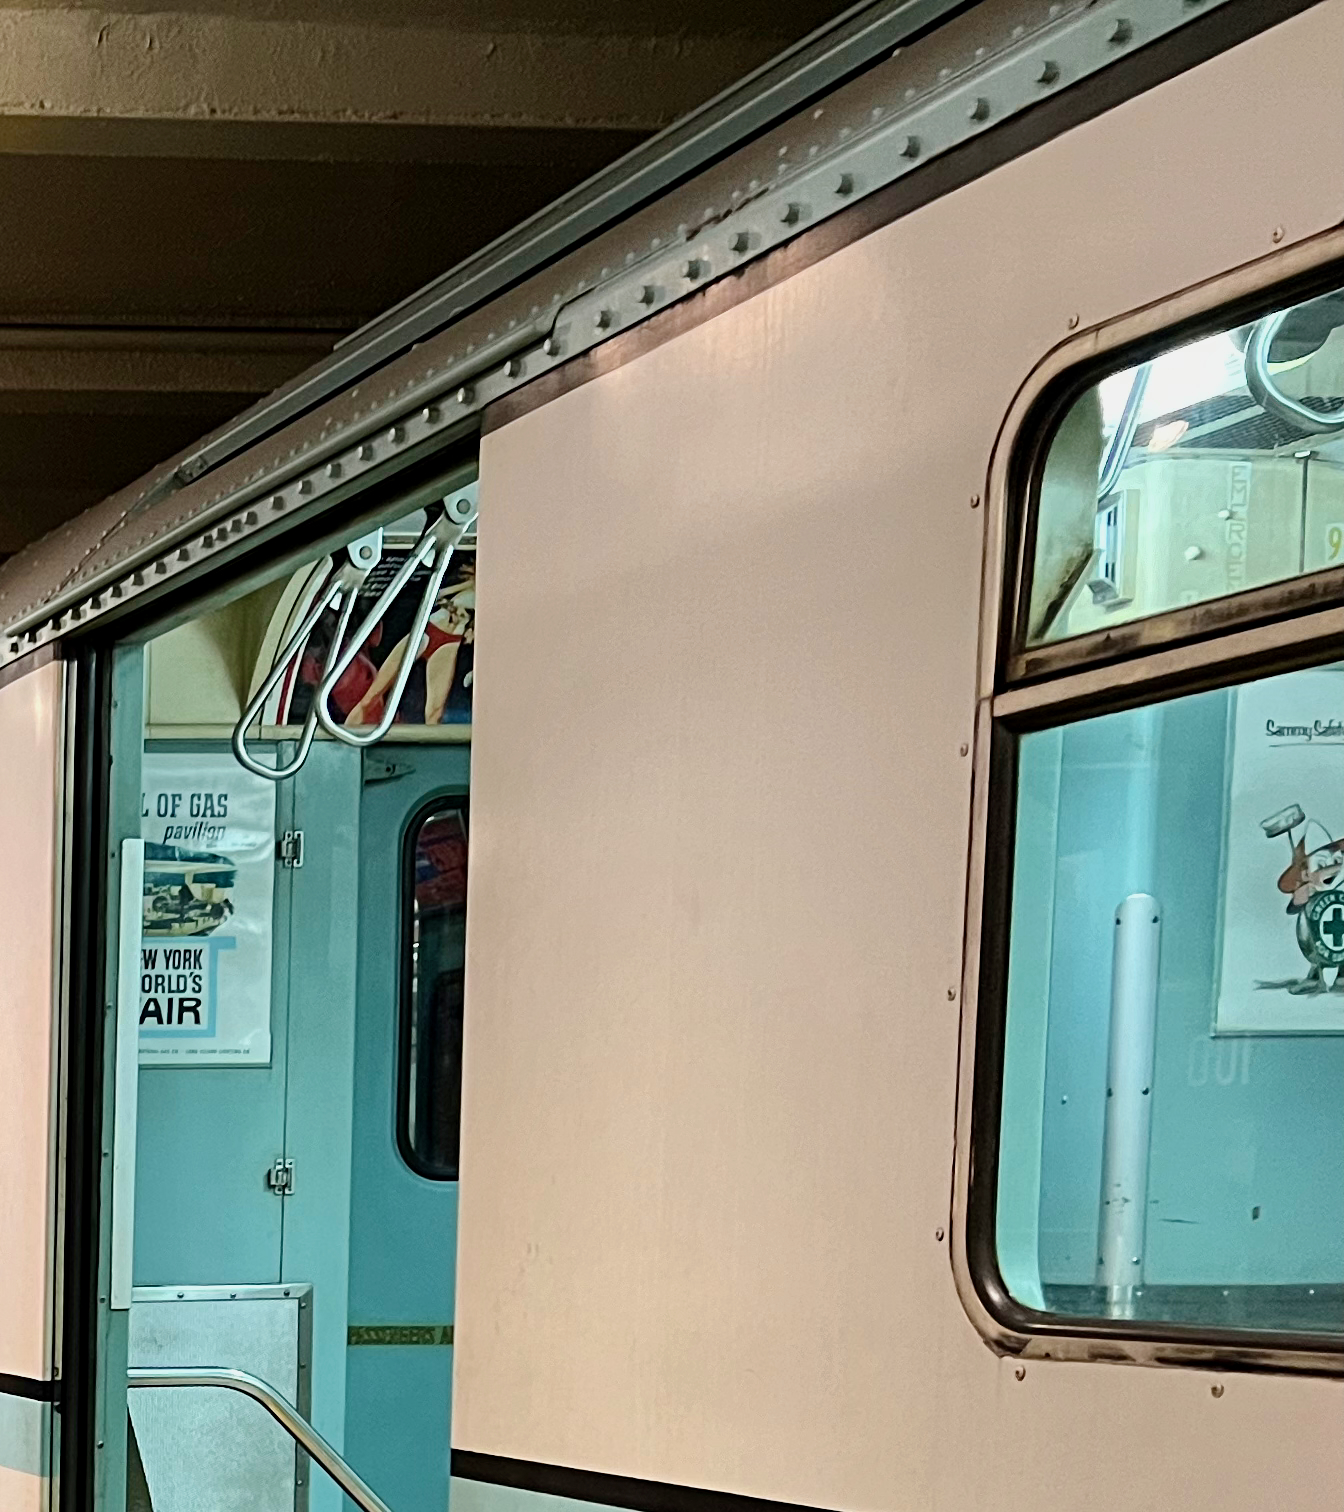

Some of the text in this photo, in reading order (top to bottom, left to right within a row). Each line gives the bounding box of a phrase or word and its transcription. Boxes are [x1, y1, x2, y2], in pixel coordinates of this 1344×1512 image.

[157, 793, 182, 818] OF
[190, 793, 228, 818] GAS
[162, 821, 226, 845] pavilion
[164, 949, 203, 970] YORK
